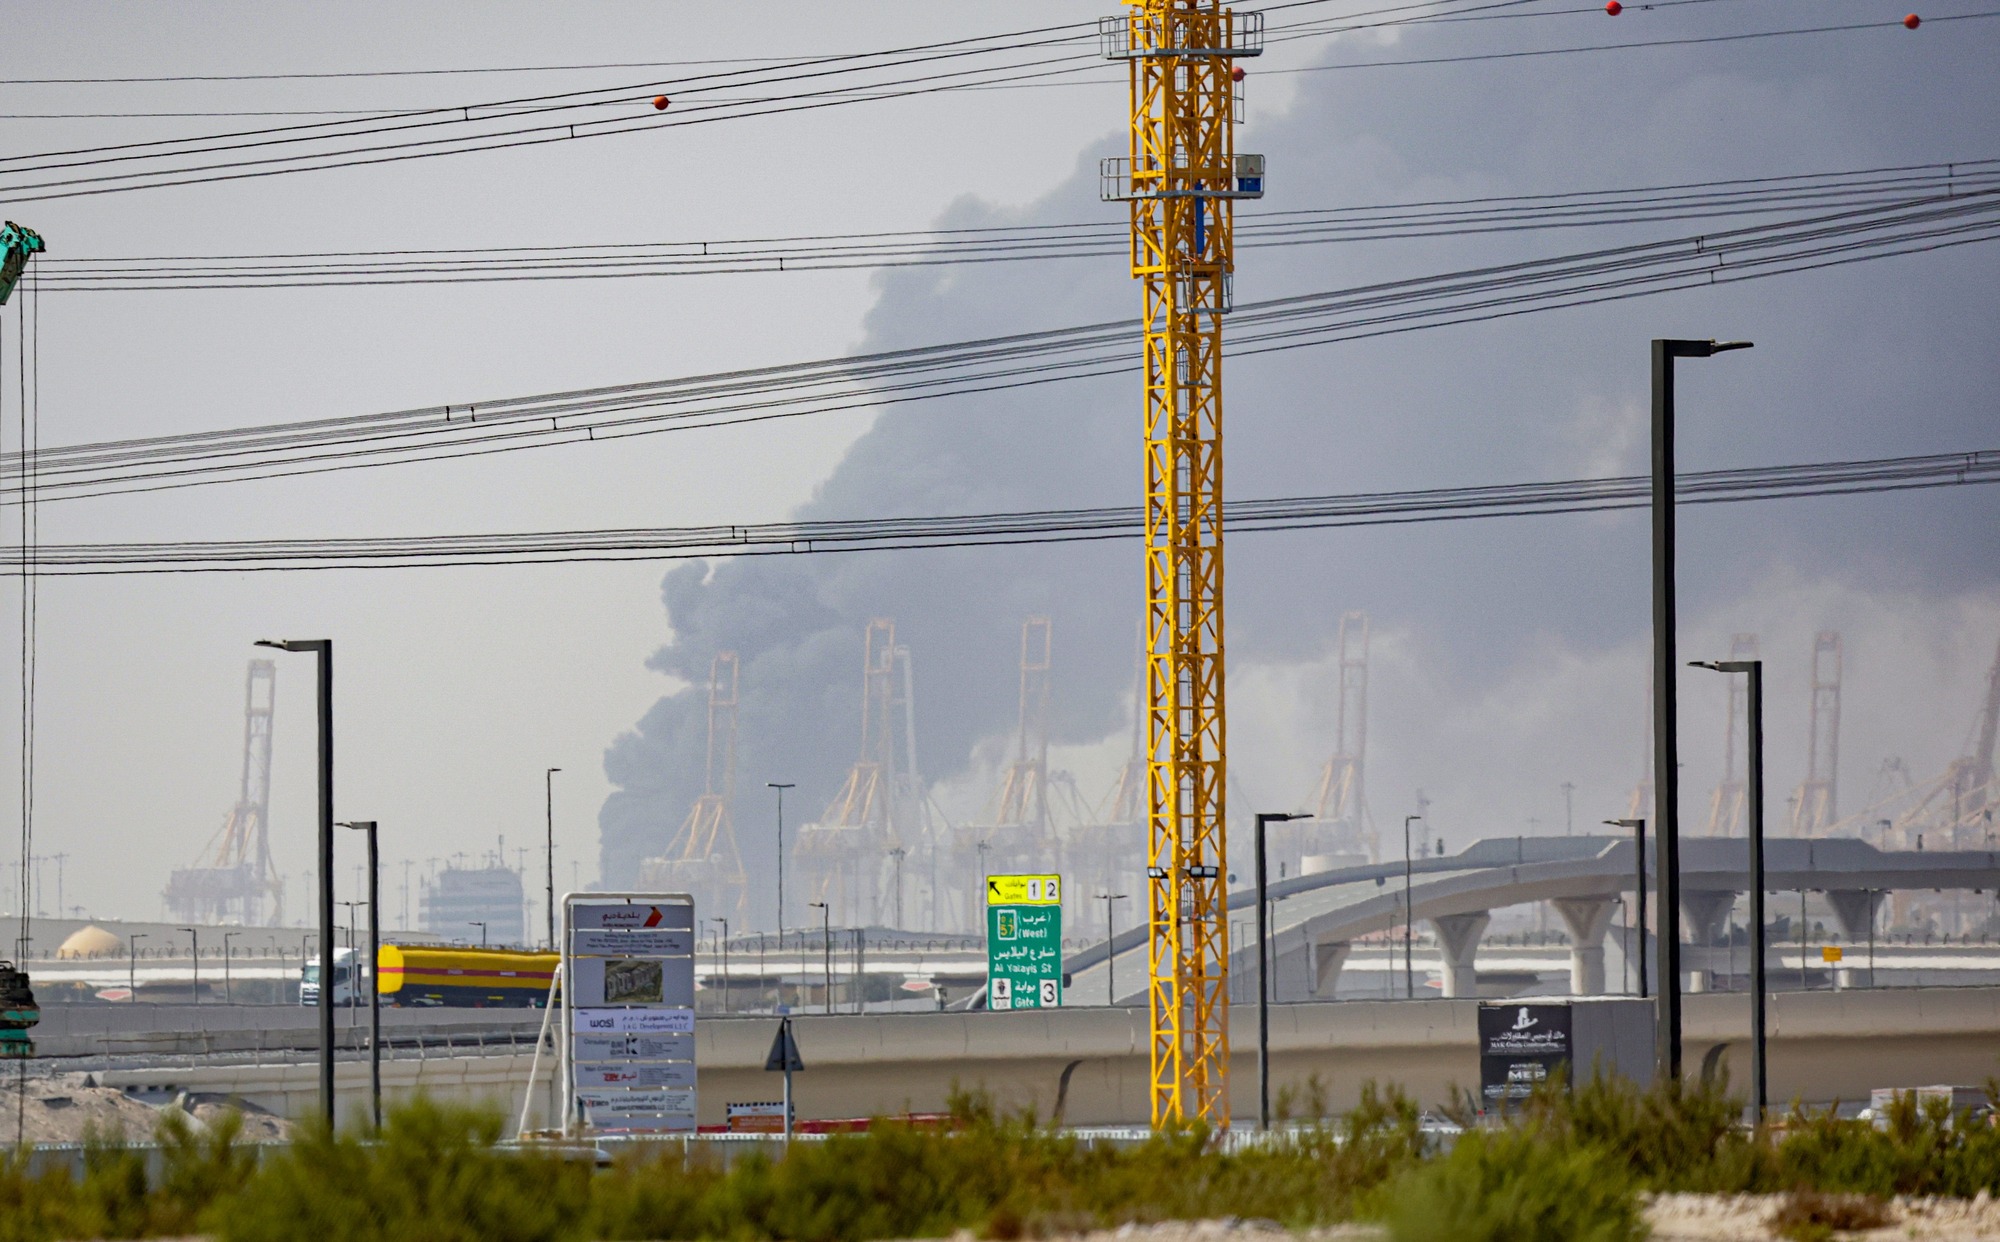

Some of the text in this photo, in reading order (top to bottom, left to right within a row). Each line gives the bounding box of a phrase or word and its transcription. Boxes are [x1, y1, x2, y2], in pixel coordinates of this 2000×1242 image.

[1031, 882, 1056, 897] 1 2
[1004, 892, 1022, 900] Gates
[1000, 924, 1014, 936] 57
[1018, 927, 1047, 939] (West)
[1041, 963, 1053, 974] St
[1043, 983, 1055, 1003] 3
[1014, 997, 1035, 1008] Gate
